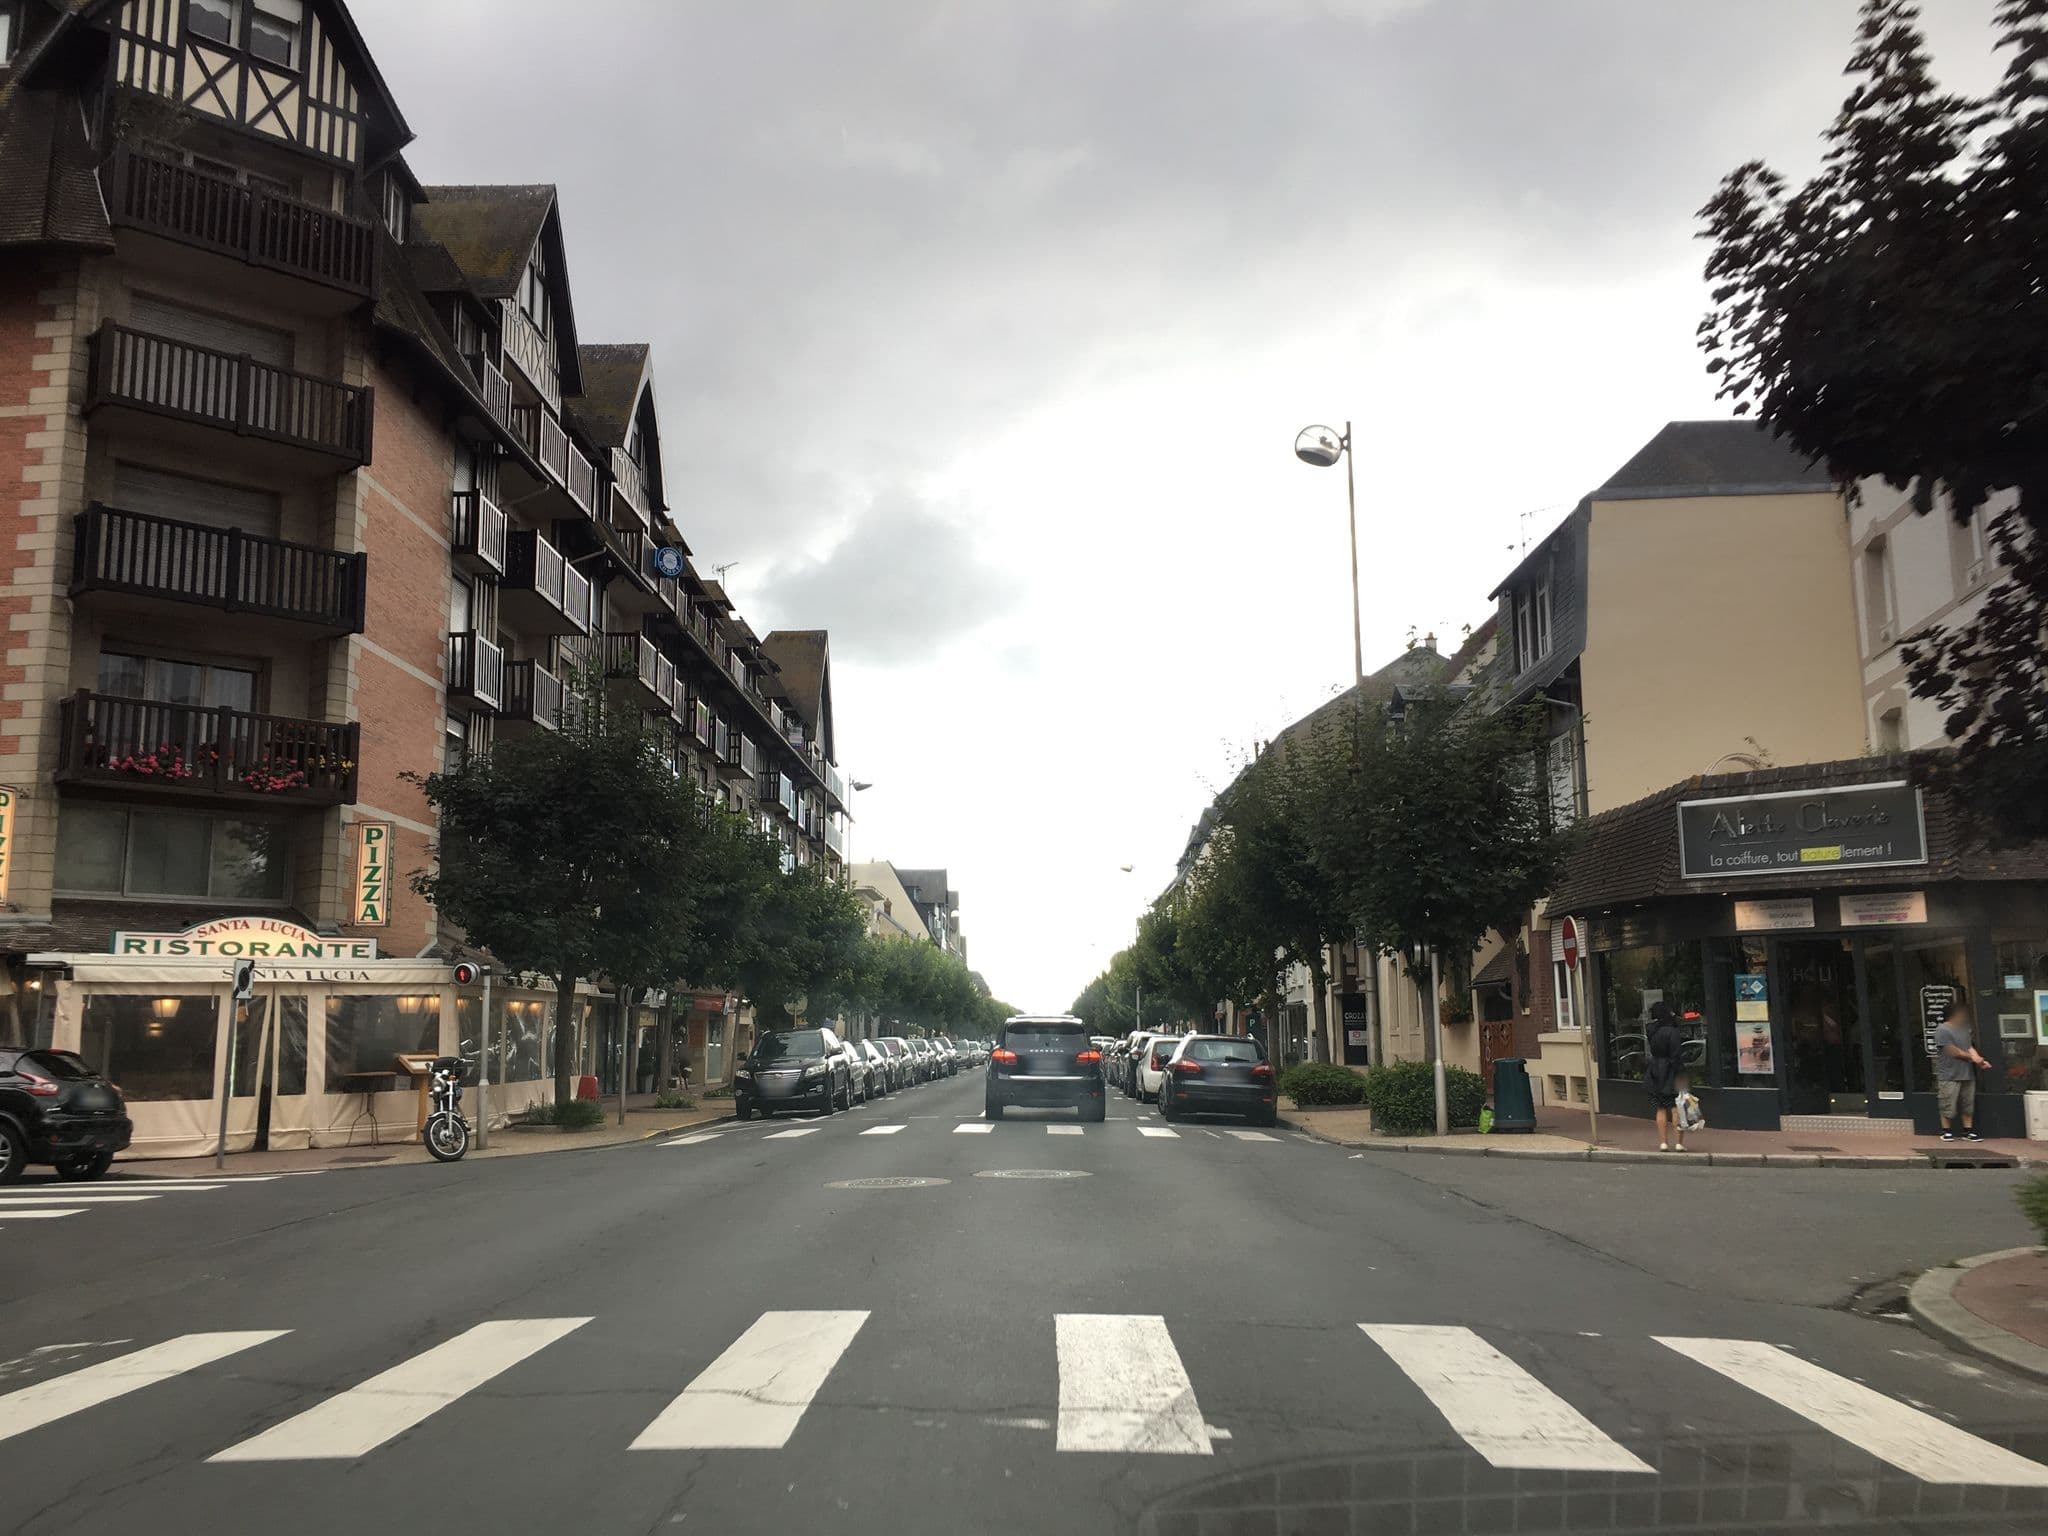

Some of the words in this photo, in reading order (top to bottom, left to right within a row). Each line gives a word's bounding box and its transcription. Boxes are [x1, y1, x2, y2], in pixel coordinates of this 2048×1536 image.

[1710, 855, 1723, 867] La
[1726, 850, 1773, 866] coiffure,
[1776, 850, 1799, 862] tout
[361, 827, 383, 921] PIZZA
[197, 919, 251, 938] SANTA
[260, 920, 306, 942] LUCIA
[124, 938, 370, 958] RISTORANTE
[222, 968, 295, 980] SNTA
[305, 970, 370, 981] LUCIA
